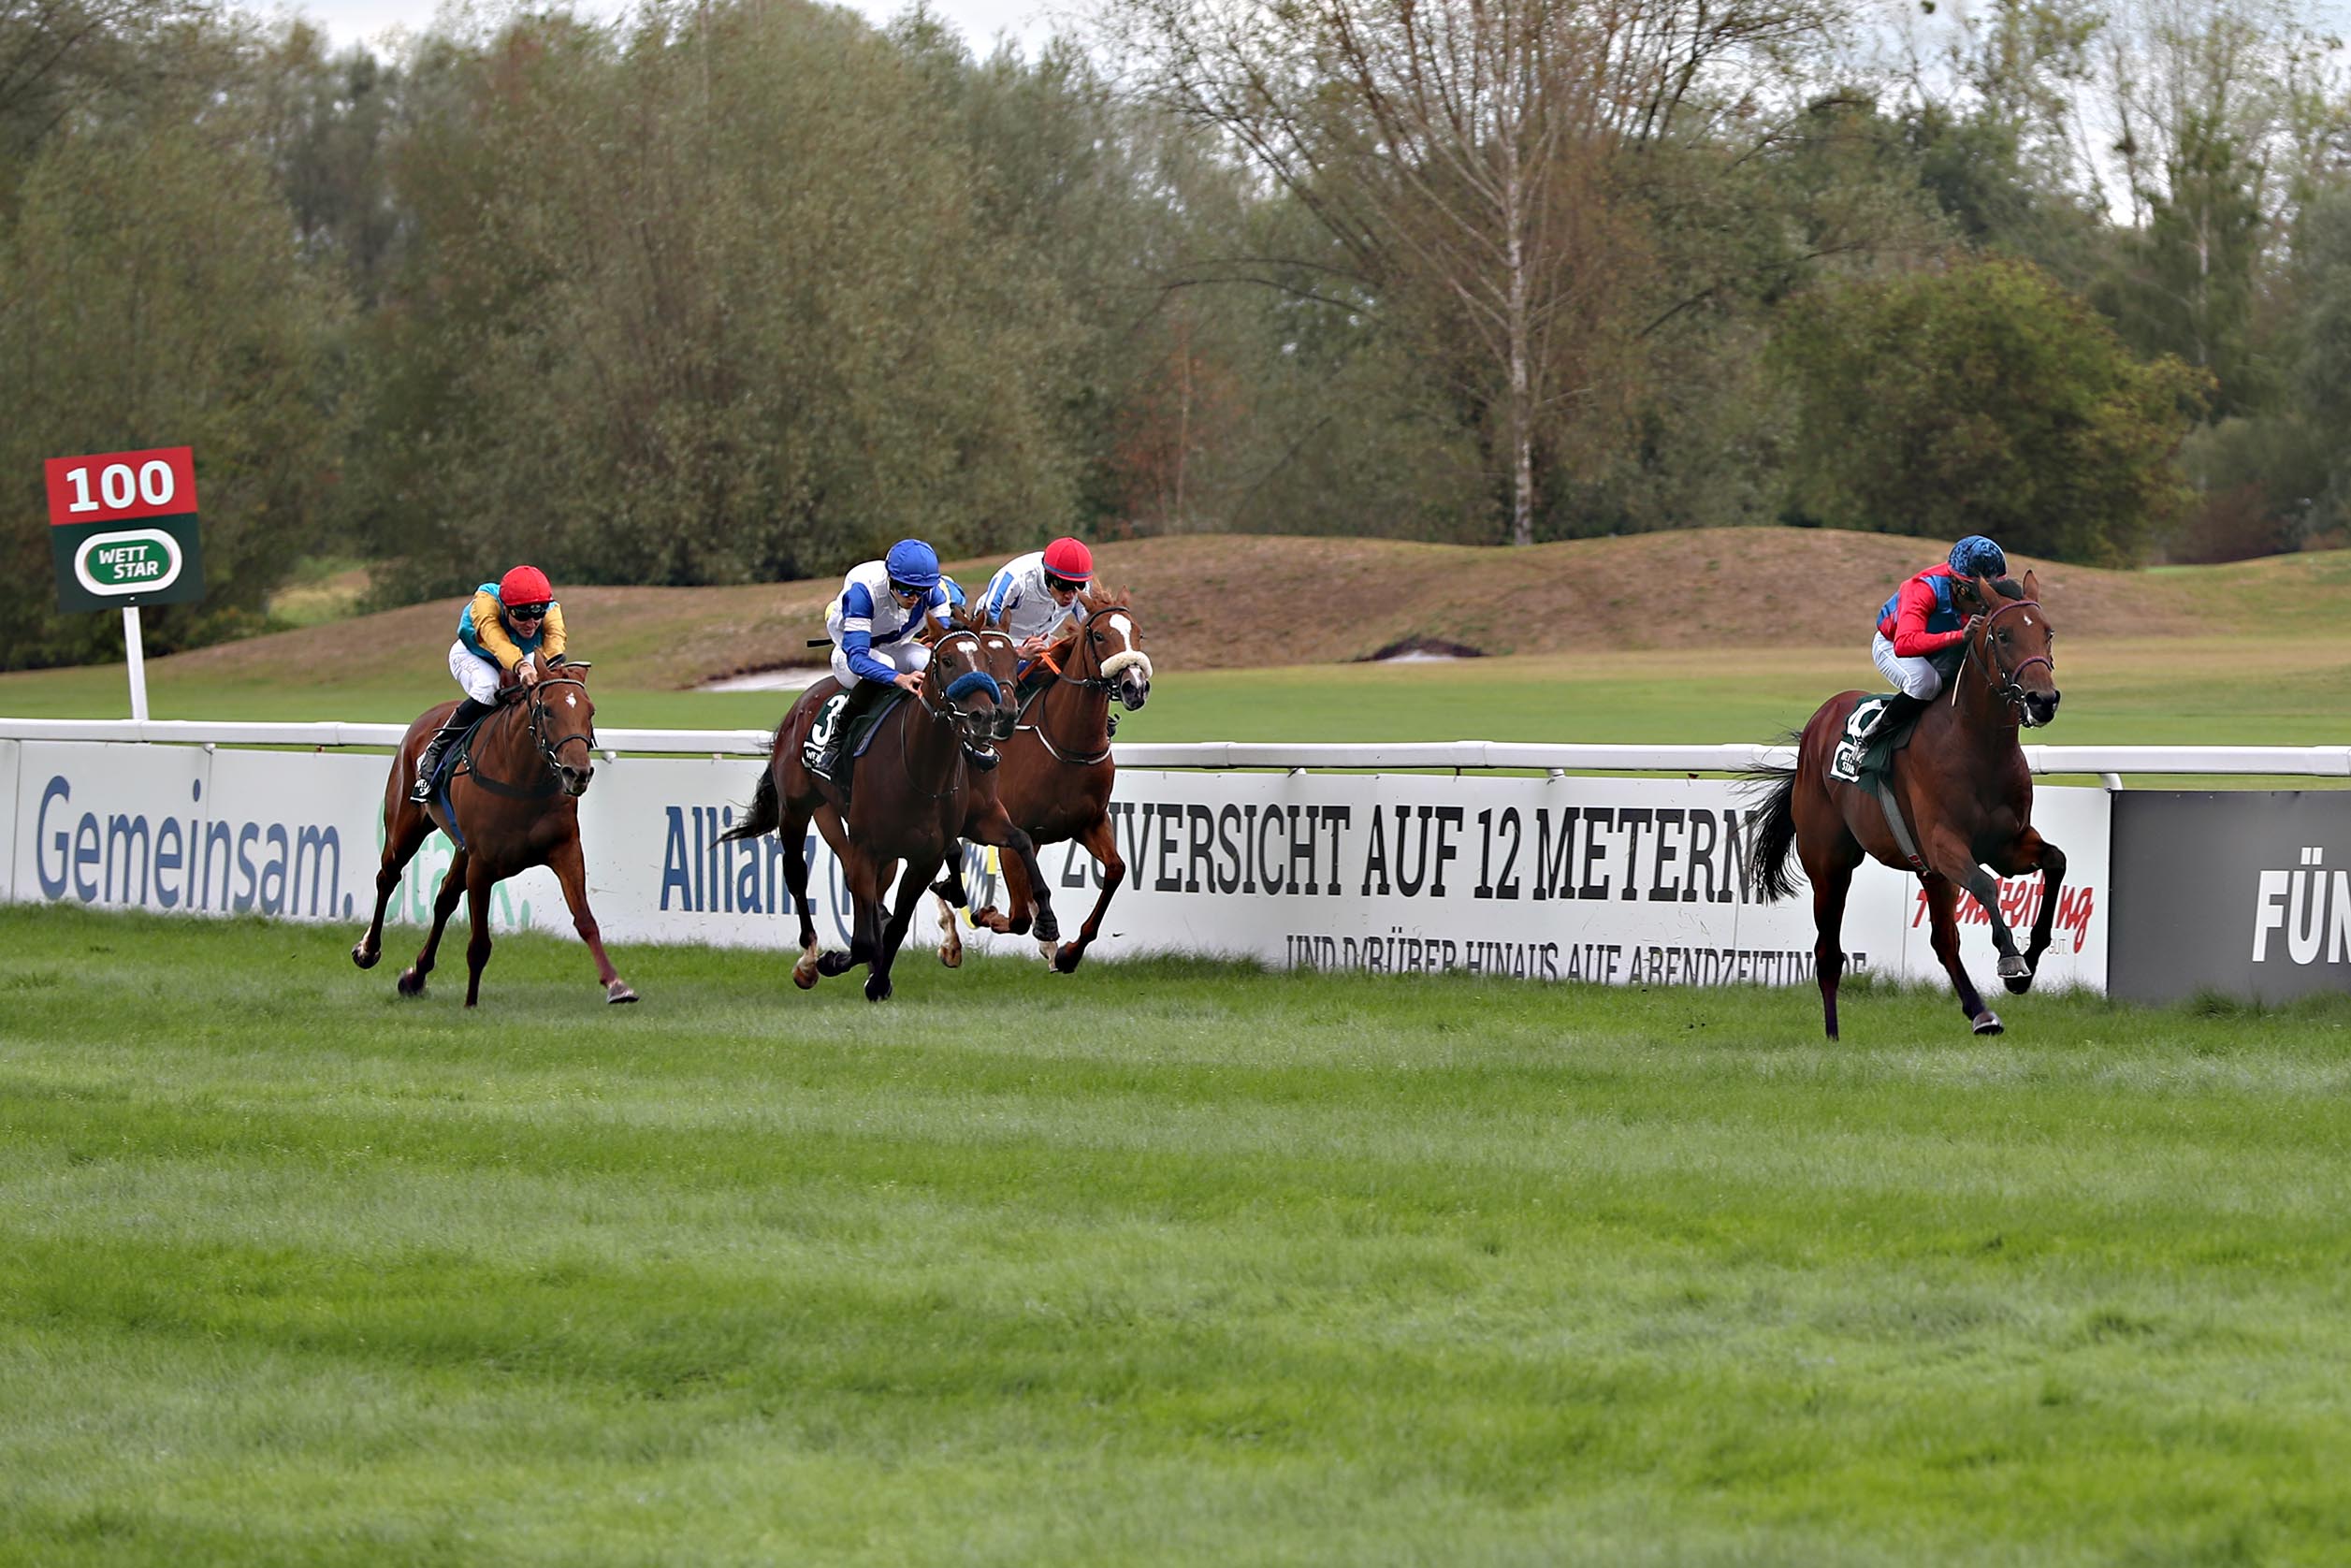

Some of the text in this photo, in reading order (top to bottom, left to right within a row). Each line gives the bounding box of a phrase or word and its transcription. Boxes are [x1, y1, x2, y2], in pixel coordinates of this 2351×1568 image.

[65, 460, 175, 512] 100
[98, 545, 148, 564] WETT
[113, 561, 159, 579] STAR
[811, 694, 846, 746] 3
[36, 776, 354, 919] Gemeinsam.
[660, 806, 817, 915] Allianz
[1361, 804, 1464, 898] AUF
[1474, 806, 1521, 900] 12
[1286, 935, 1336, 970] UND
[1567, 943, 1621, 985] AUF
